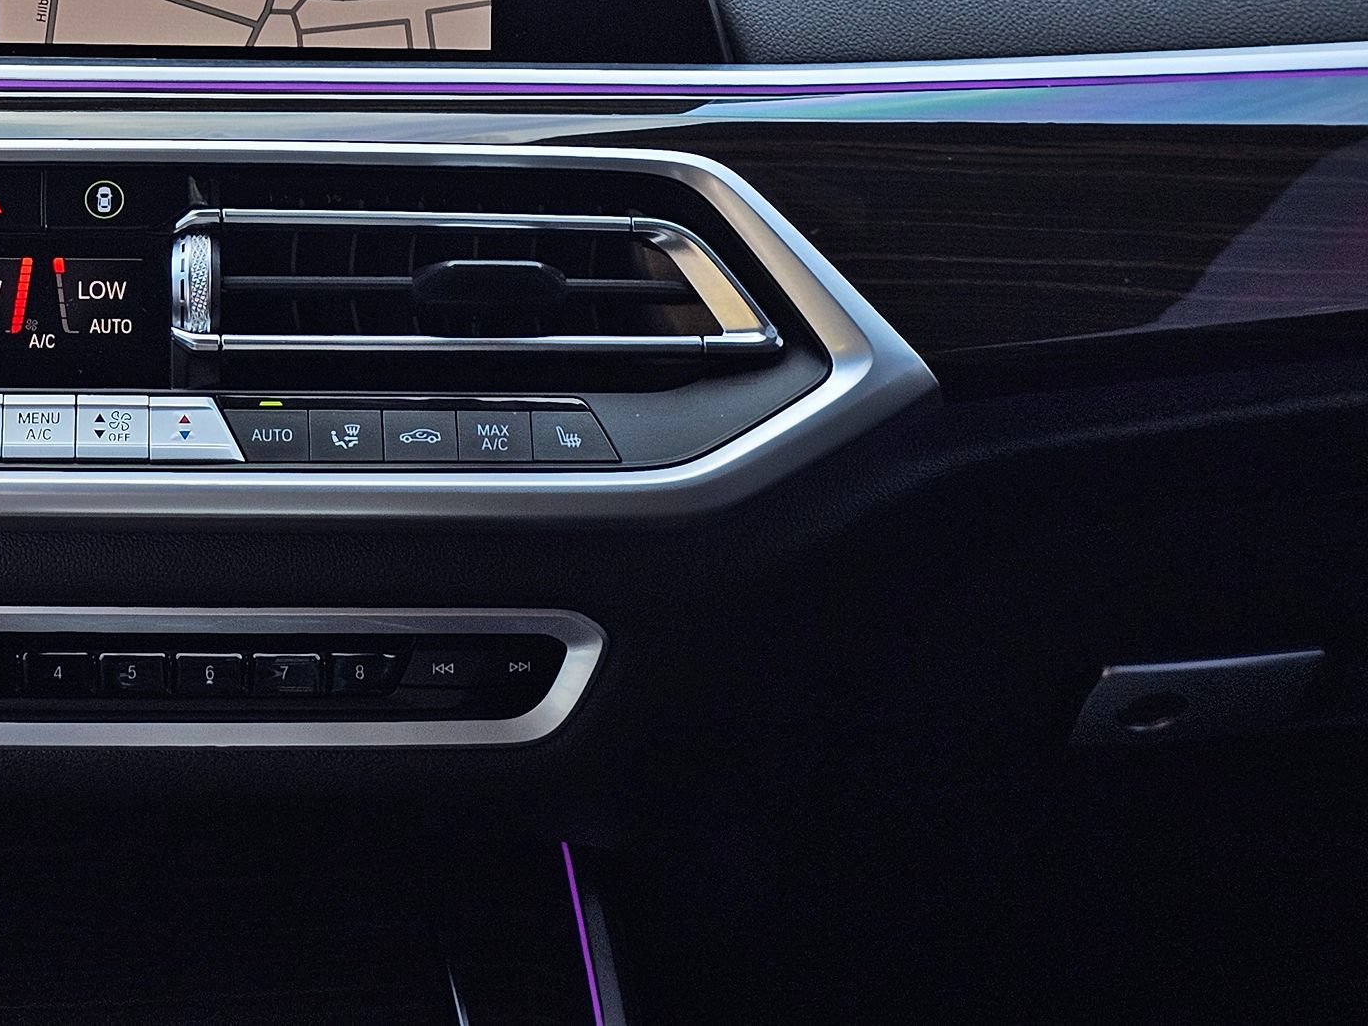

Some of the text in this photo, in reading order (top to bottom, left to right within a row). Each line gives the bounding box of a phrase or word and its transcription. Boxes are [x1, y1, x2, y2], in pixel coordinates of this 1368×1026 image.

[77, 279, 128, 301] LOW
[89, 318, 133, 335] AUTO
[28, 333, 56, 350] A/C
[16, 411, 61, 425] MENU
[25, 427, 52, 442] A/C
[108, 432, 131, 443] OFF
[250, 428, 294, 443] AUTO
[477, 423, 510, 437] MAX
[480, 436, 509, 452] A/C
[52, 664, 63, 680] 4
[127, 664, 138, 681] 5
[204, 665, 215, 680] 6
[279, 664, 289, 681] 7
[354, 664, 365, 681] 8
